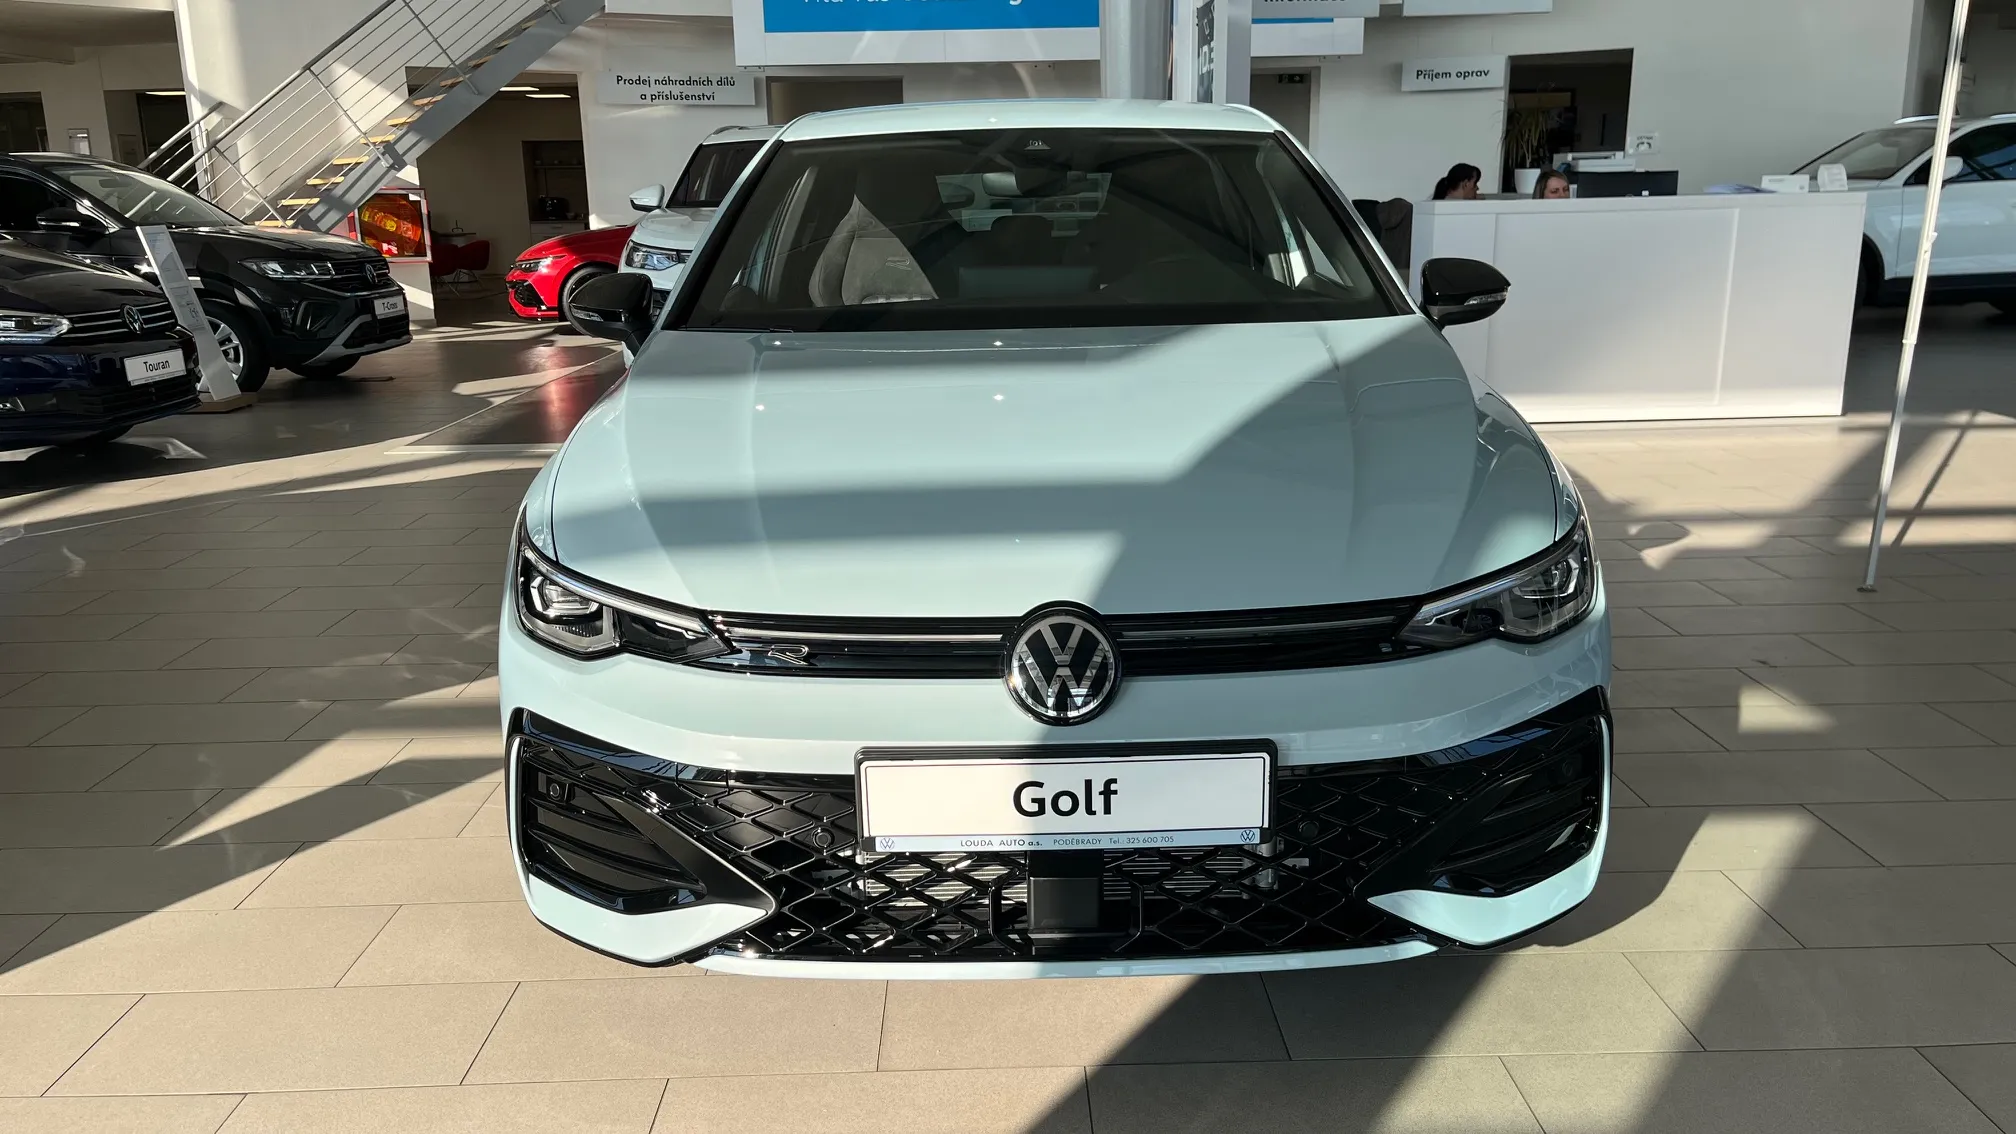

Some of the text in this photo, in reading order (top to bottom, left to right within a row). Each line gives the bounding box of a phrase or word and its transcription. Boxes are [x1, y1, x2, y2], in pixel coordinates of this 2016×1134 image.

[616, 75, 736, 87] Prodej náhradních dílů
[1416, 69, 1490, 82] Příjem oprav
[640, 91, 715, 102] a příslušenství
[143, 360, 171, 373] Touran
[1012, 777, 1119, 818] Golf
[960, 839, 994, 847] LOUDA
[998, 839, 1026, 847] AUTO
[1053, 837, 1102, 846] PODĚBRADY
[1126, 837, 1141, 845] 325
[1142, 836, 1158, 844] 600
[1160, 835, 1174, 843] 705
